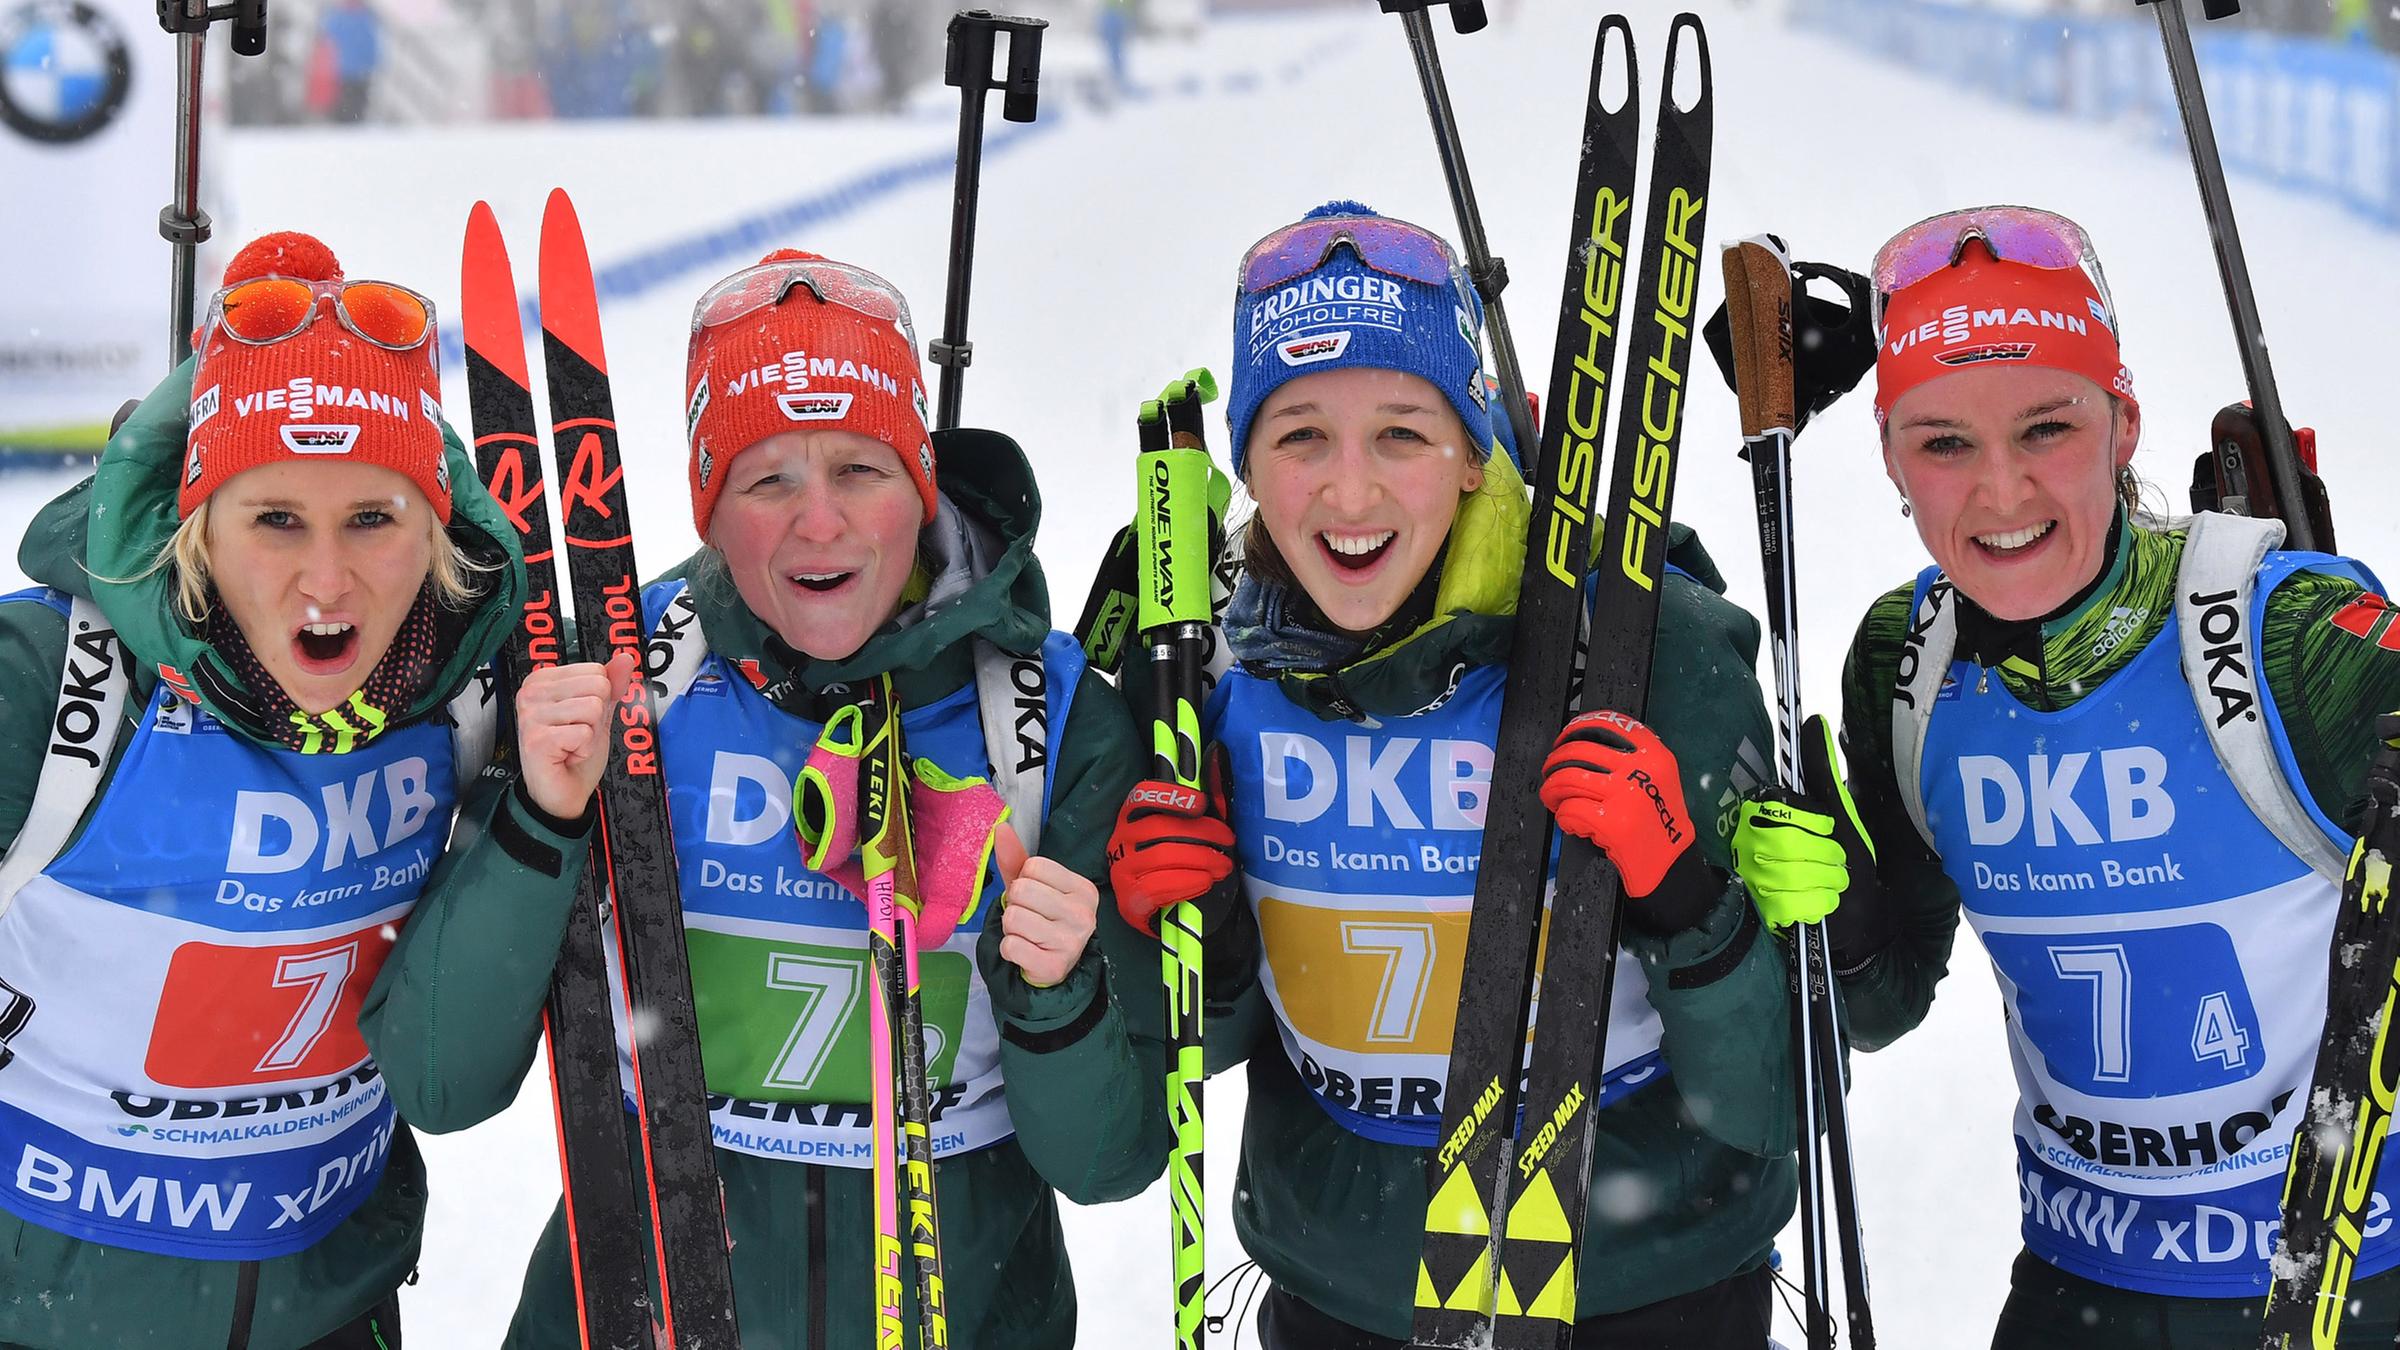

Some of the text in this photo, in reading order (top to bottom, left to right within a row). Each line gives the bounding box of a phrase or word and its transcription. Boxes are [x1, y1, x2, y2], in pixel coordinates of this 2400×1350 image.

[1250, 275, 1407, 335] ERDINGER
[1250, 306, 1402, 355] ALKOHOLFREI
[1890, 305, 2088, 357] VIESSMANN
[234, 377, 409, 422] VIESSMANN
[728, 350, 898, 399] VIESSMANN
[1546, 186, 1629, 589] FISCHER
[1622, 187, 1703, 592] FISCHER
[604, 575, 656, 775] ROSSGNOL
[1893, 580, 1954, 710] JOKA
[2092, 606, 2150, 657] adidas
[2189, 589, 2255, 729] JOKA
[51, 622, 117, 768] JOKA
[225, 757, 436, 875] DKB
[868, 758, 885, 821] LEKI
[1259, 731, 1497, 831] DKB
[1957, 745, 2176, 848] DKB
[215, 849, 431, 913] Das kann Bank
[701, 859, 764, 894] Das
[1263, 834, 1480, 875] Das kann Ban
[1974, 853, 2185, 892] Das kann Bank
[253, 940, 359, 1073] 7
[762, 952, 864, 1090] 7
[1340, 921, 1437, 1044] 7
[2190, 991, 2248, 1070] 4
[152, 1083, 383, 1145] SCHMALKALDEN-MEININ
[1300, 1050, 1442, 1117] OBER
[1438, 1074, 1505, 1173] SPEED MAX
[1518, 1080, 1586, 1180] SPEED MAX
[15, 1108, 399, 1232] BMW xDriv
[904, 1121, 936, 1260] LEKI
[880, 1233, 904, 1350] LEK
